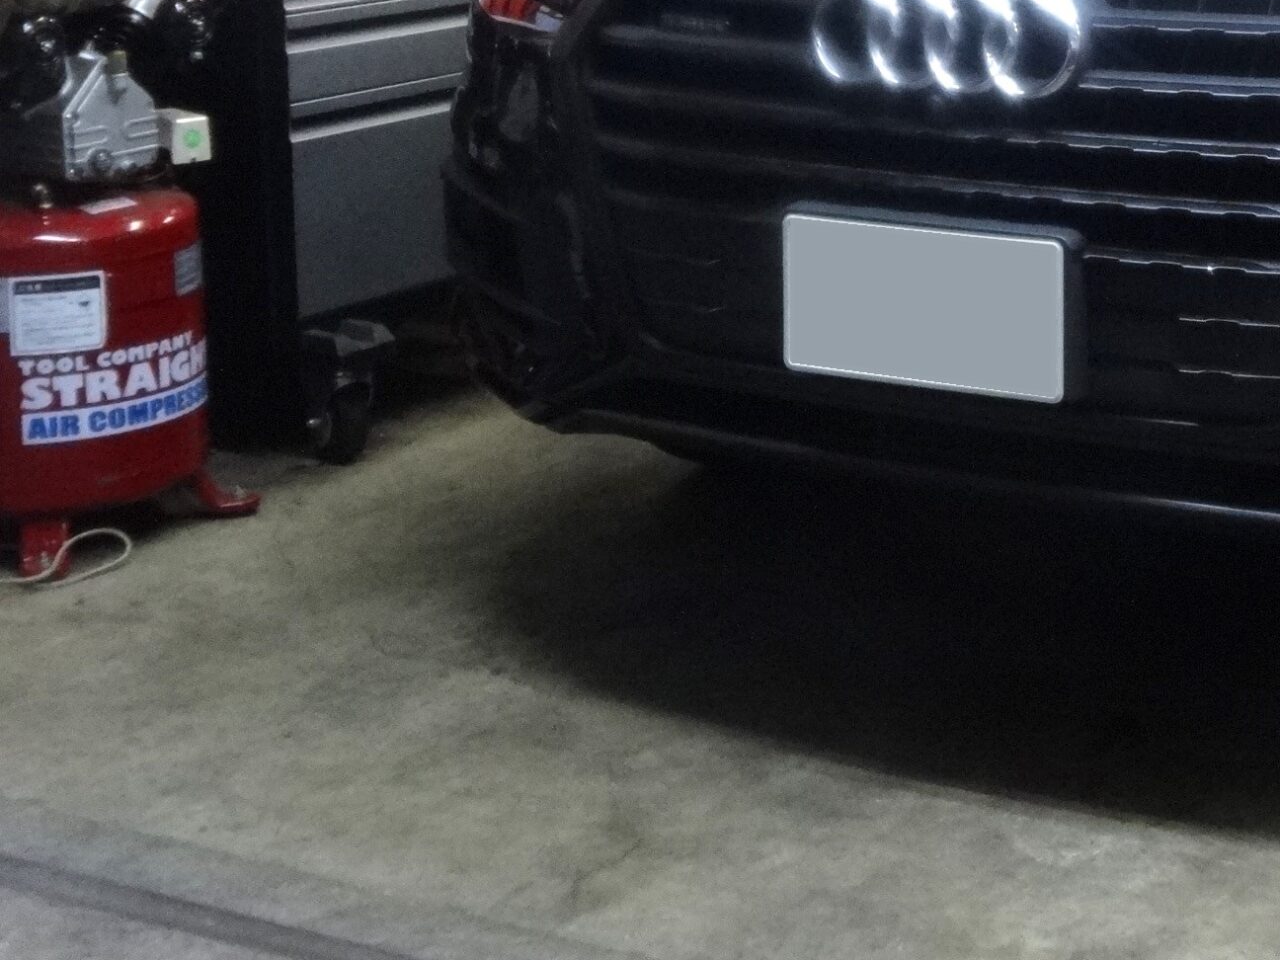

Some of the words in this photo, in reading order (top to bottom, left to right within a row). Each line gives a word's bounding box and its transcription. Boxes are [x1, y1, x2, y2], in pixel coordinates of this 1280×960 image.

[18, 355, 89, 376] TOOL
[96, 330, 193, 368] COMPANY
[20, 337, 207, 411] STRAIGH
[27, 414, 81, 440] AIR
